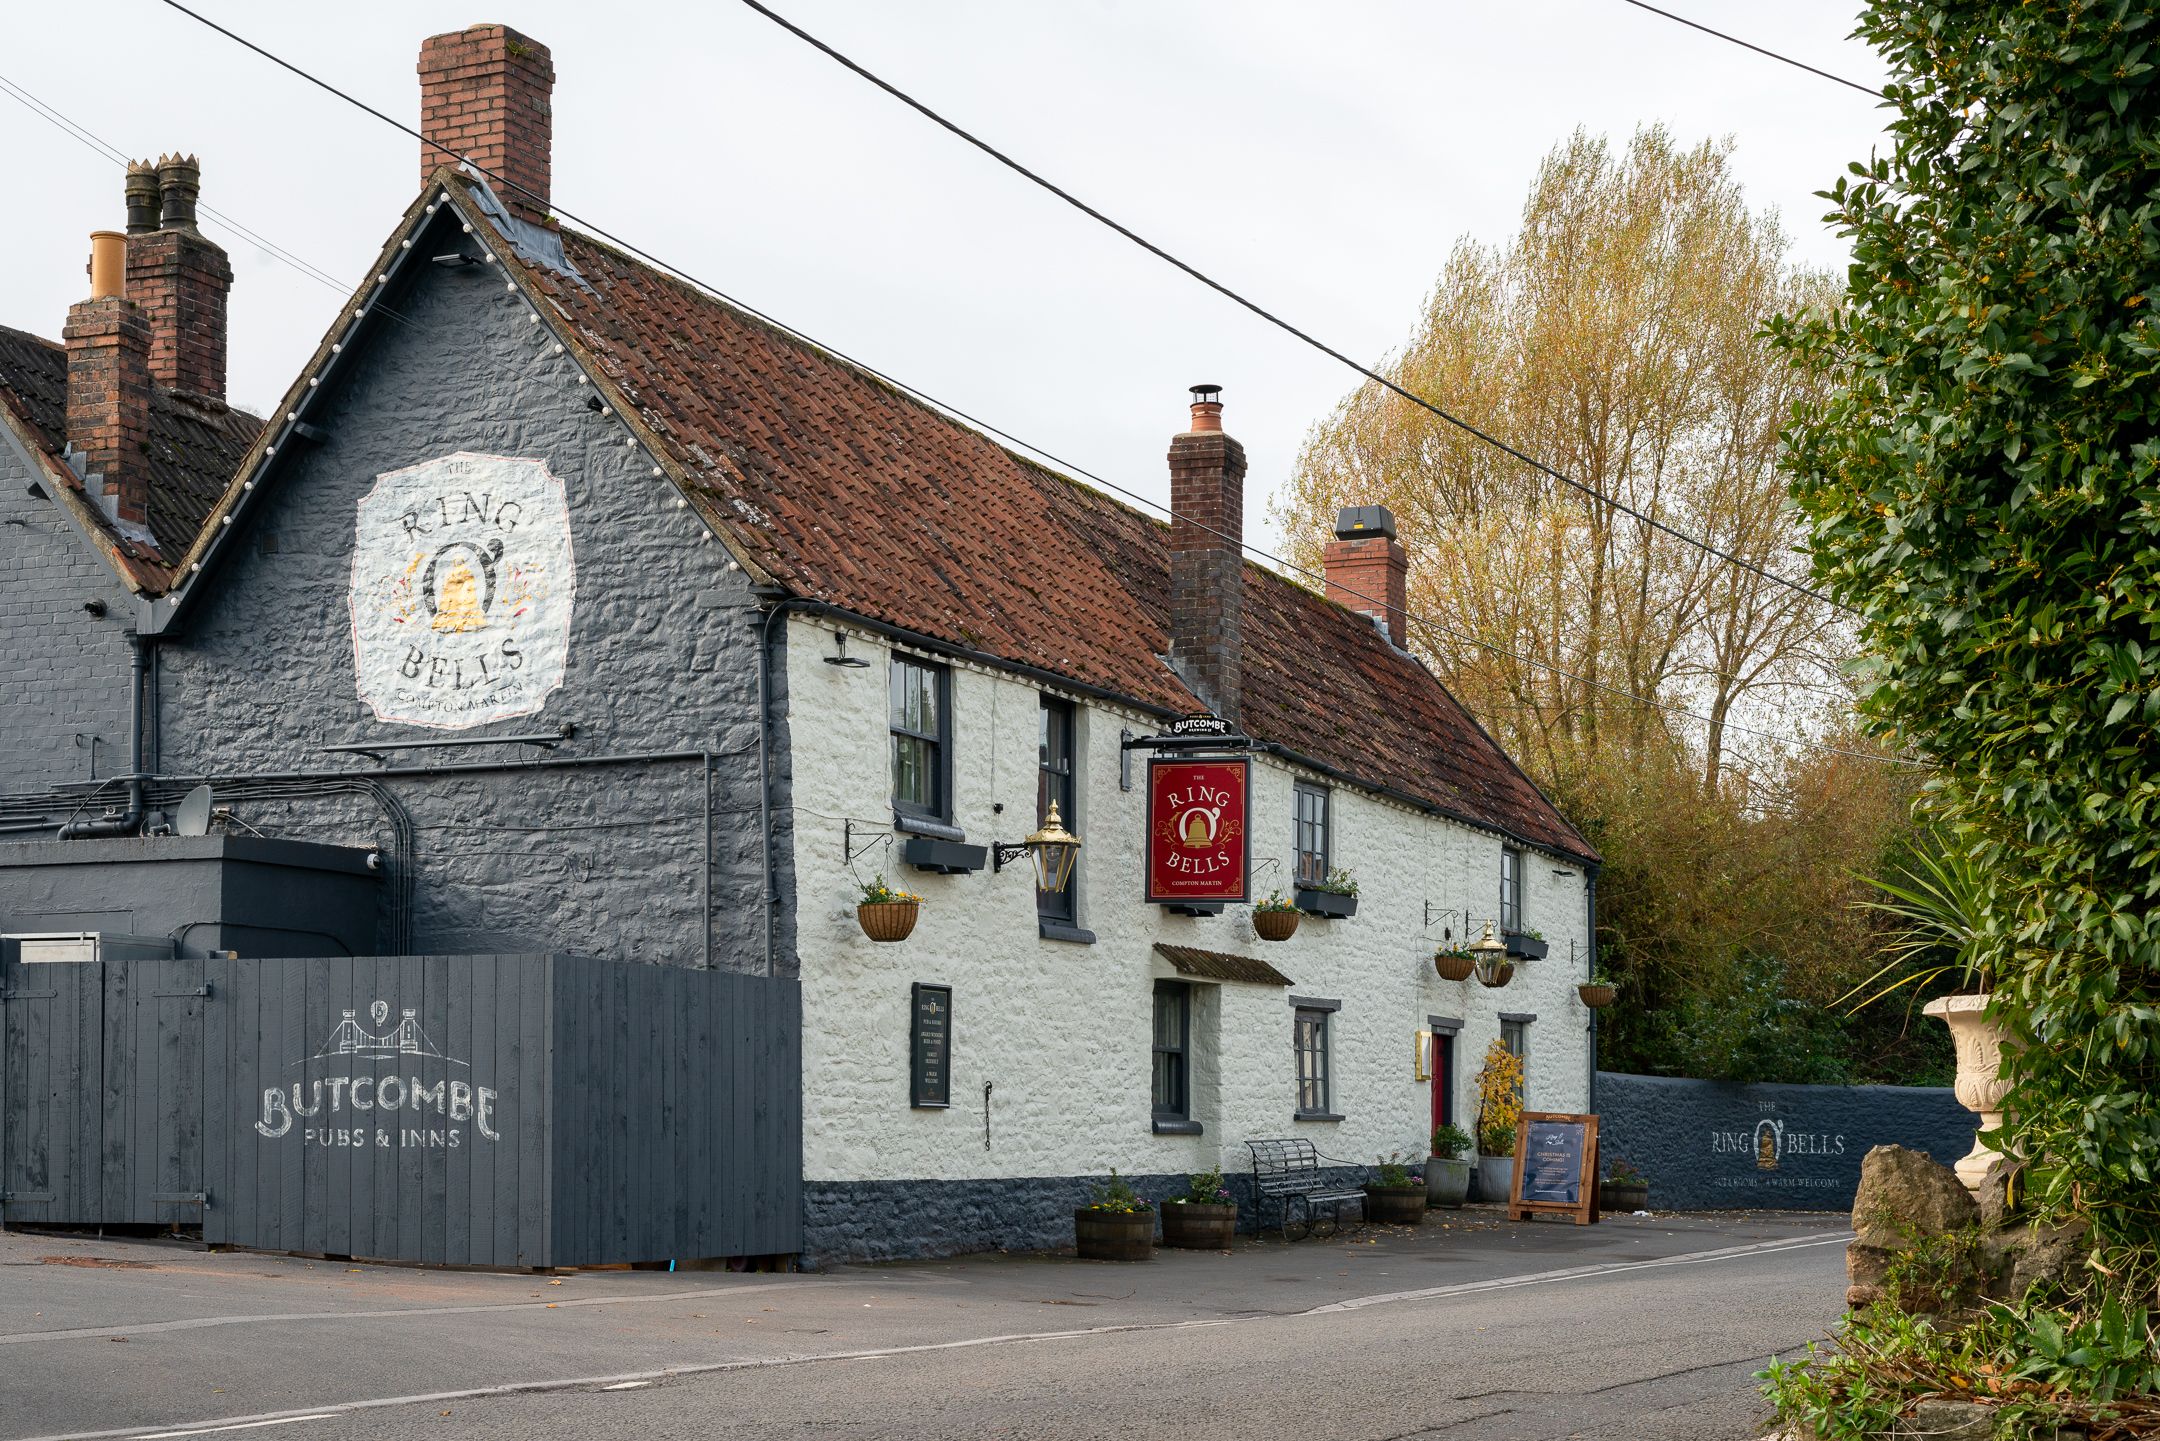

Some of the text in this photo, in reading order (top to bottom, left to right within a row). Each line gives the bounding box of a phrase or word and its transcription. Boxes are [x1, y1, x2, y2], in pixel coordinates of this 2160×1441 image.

[448, 461, 473, 475] THE
[399, 492, 523, 543] RING
[397, 638, 523, 691] BELLS
[1173, 719, 1226, 734] BUTCOMBE
[1167, 785, 1230, 809] RING
[1165, 850, 1230, 874] BELLS
[255, 1075, 500, 1141] BUTCOMBE
[1758, 1101, 1776, 1111] THE
[304, 1128, 460, 1148] PUBS & INNS
[1712, 1131, 1748, 1153] RING
[1787, 1133, 1845, 1155] BELLS
